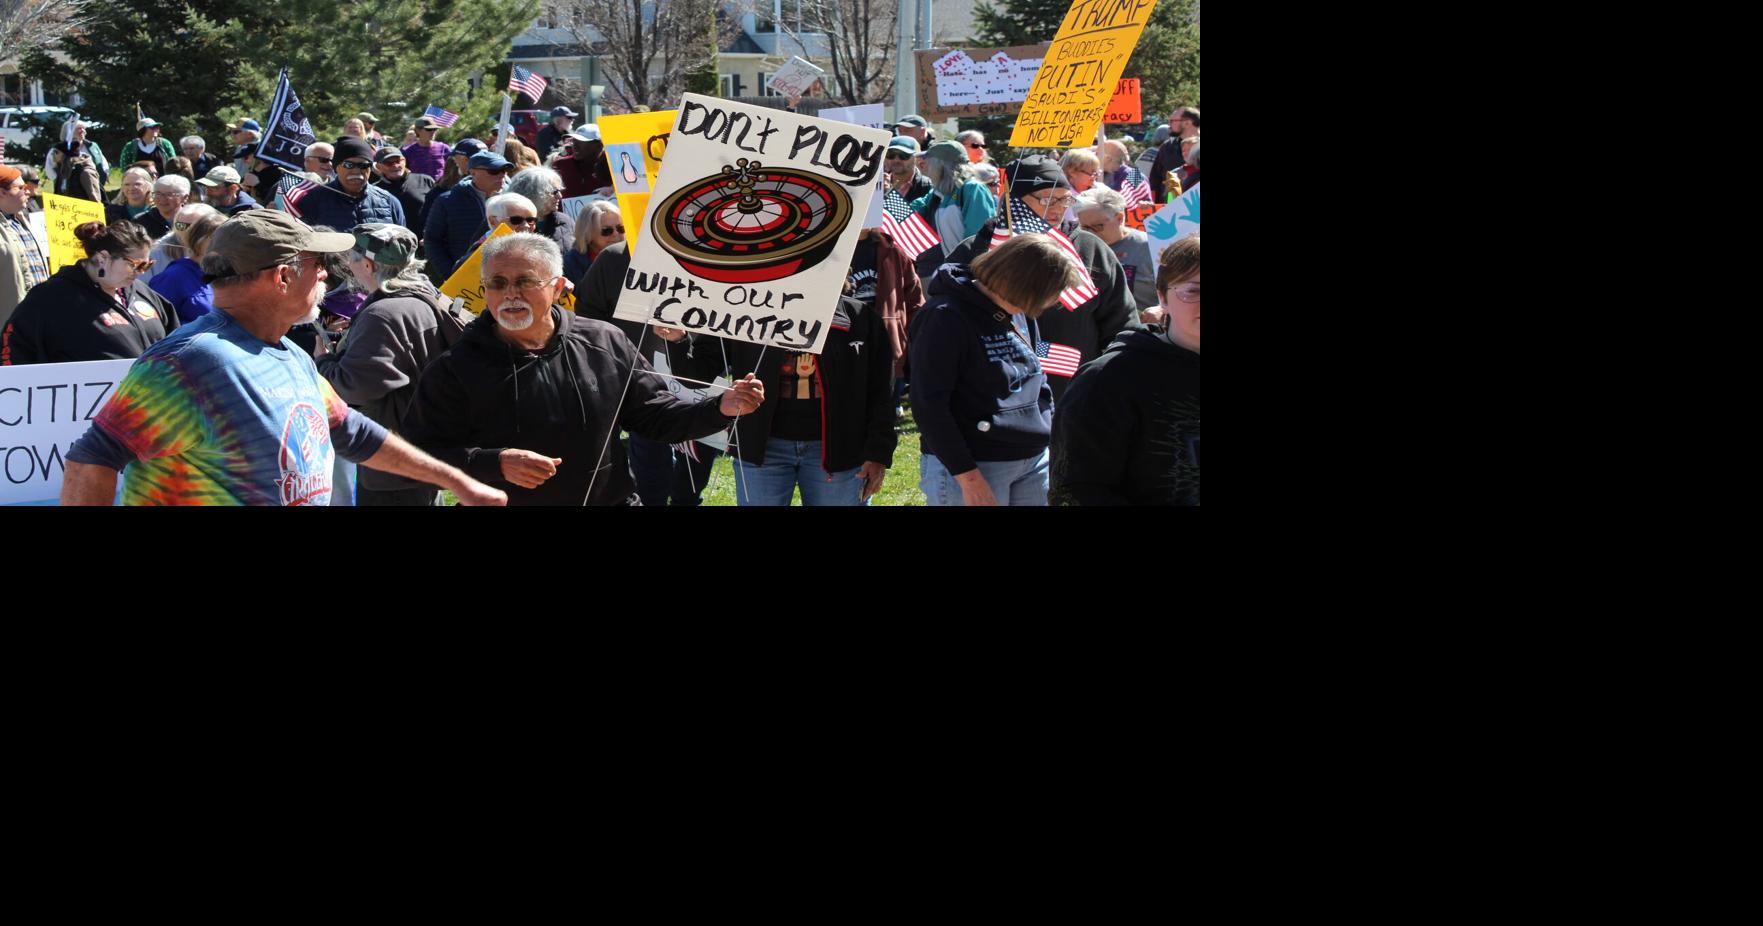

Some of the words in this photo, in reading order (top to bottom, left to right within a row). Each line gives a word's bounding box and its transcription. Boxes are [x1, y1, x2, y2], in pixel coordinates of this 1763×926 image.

[1071, 0, 1150, 31] TRUMP
[1057, 38, 1116, 60] BUDDIES
[1027, 126, 1058, 144] NOT
[1059, 123, 1084, 141] USA
[0, 381, 115, 426] CITIZ
